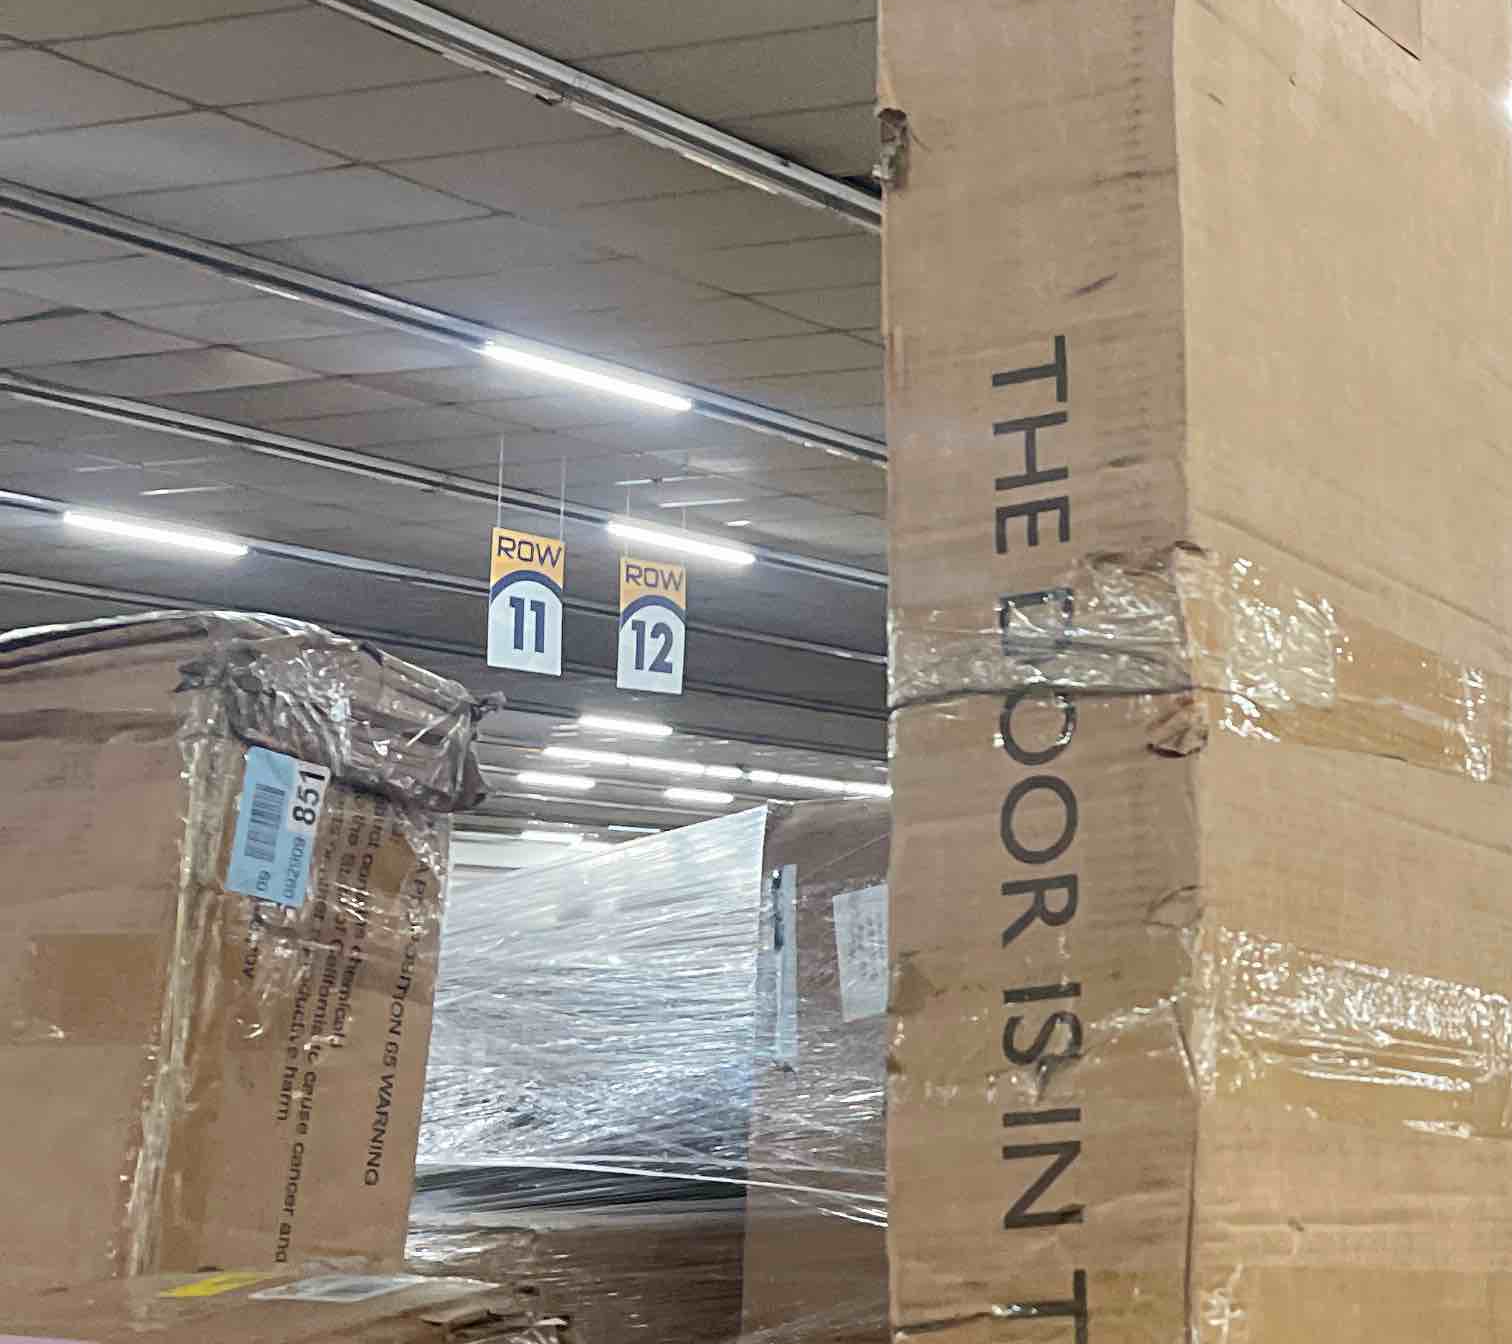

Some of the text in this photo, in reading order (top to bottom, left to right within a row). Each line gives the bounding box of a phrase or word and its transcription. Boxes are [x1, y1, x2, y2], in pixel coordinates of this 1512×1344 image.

[991, 334, 1071, 555] THE
[497, 535, 562, 569] ROW
[625, 564, 684, 592] ROW
[509, 596, 546, 654] 11
[631, 619, 674, 674] 12
[1000, 587, 1082, 949] DOOR
[291, 769, 326, 827] 851
[1002, 982, 1084, 1066] IS
[383, 1041, 400, 1069] 65
[276, 1065, 299, 1122] harm
[297, 1070, 318, 1136] cause
[364, 1072, 395, 1187] WARNING
[282, 1141, 305, 1217] cancer
[1001, 1106, 1085, 1230] IN
[274, 1221, 292, 1264] and
